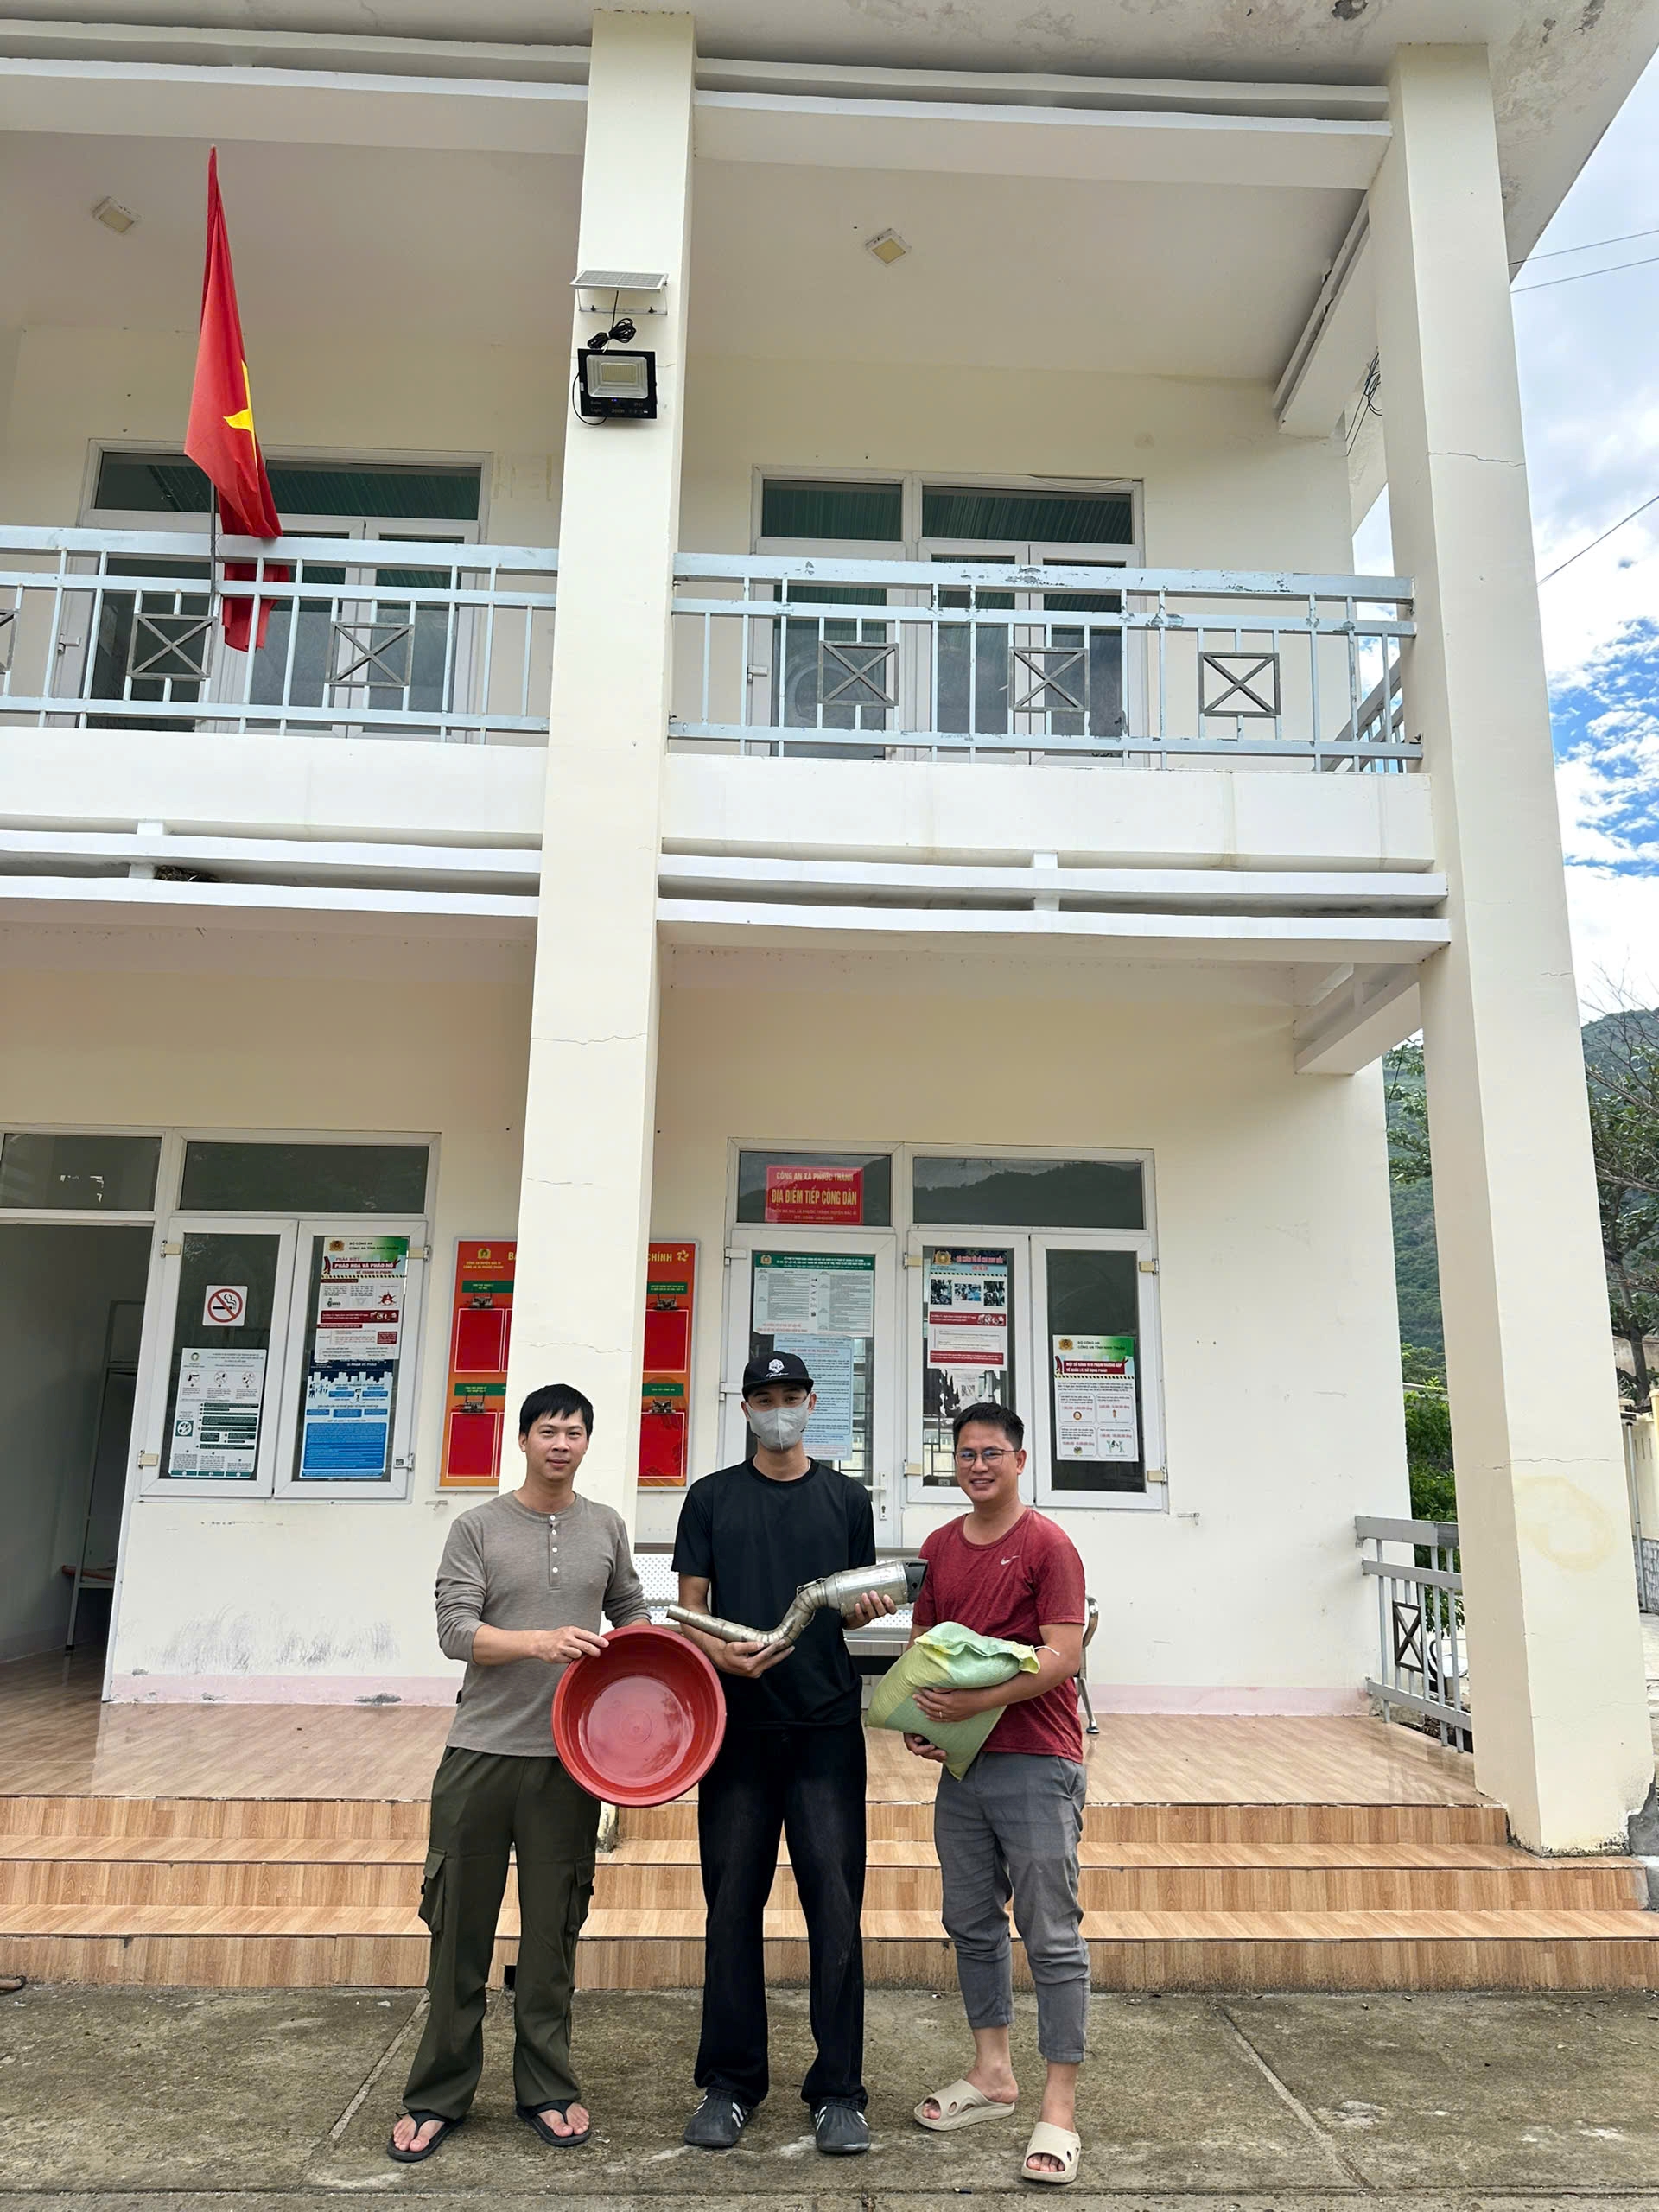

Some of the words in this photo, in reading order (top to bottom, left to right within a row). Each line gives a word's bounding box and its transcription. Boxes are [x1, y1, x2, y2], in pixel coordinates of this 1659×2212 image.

[776, 1171, 792, 1180] CÔNG
[772, 1189, 784, 1206] ĐỊA
[785, 1184, 803, 1203] ĐIỂM
[804, 1185, 820, 1204] TIẾP
[821, 1188, 841, 1205] CÔNG
[842, 1188, 857, 1205] DÂN
